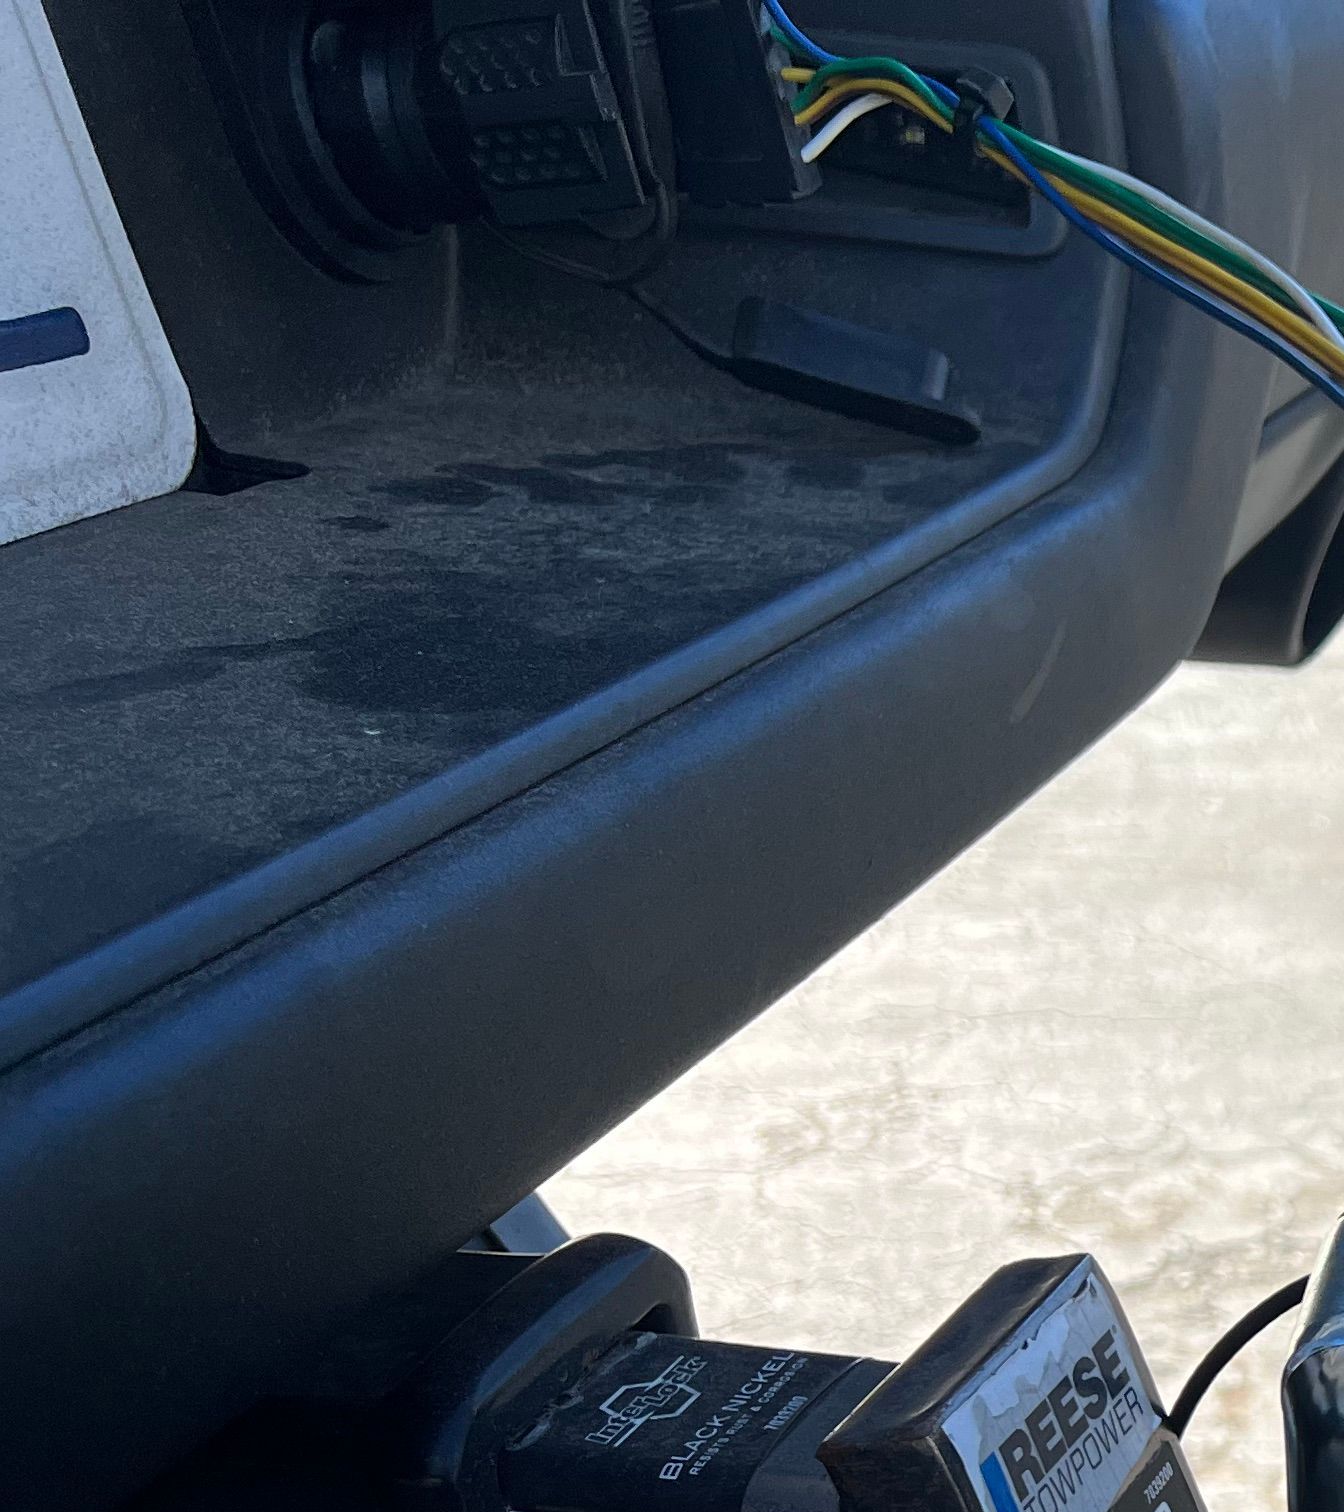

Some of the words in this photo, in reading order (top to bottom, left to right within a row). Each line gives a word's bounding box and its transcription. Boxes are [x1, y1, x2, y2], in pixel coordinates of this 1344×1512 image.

[659, 1414, 731, 1480] BLACK
[722, 1352, 795, 1412] NICKEL
[998, 1328, 1130, 1502] REESE
[1143, 1461, 1174, 1504] 7039200
